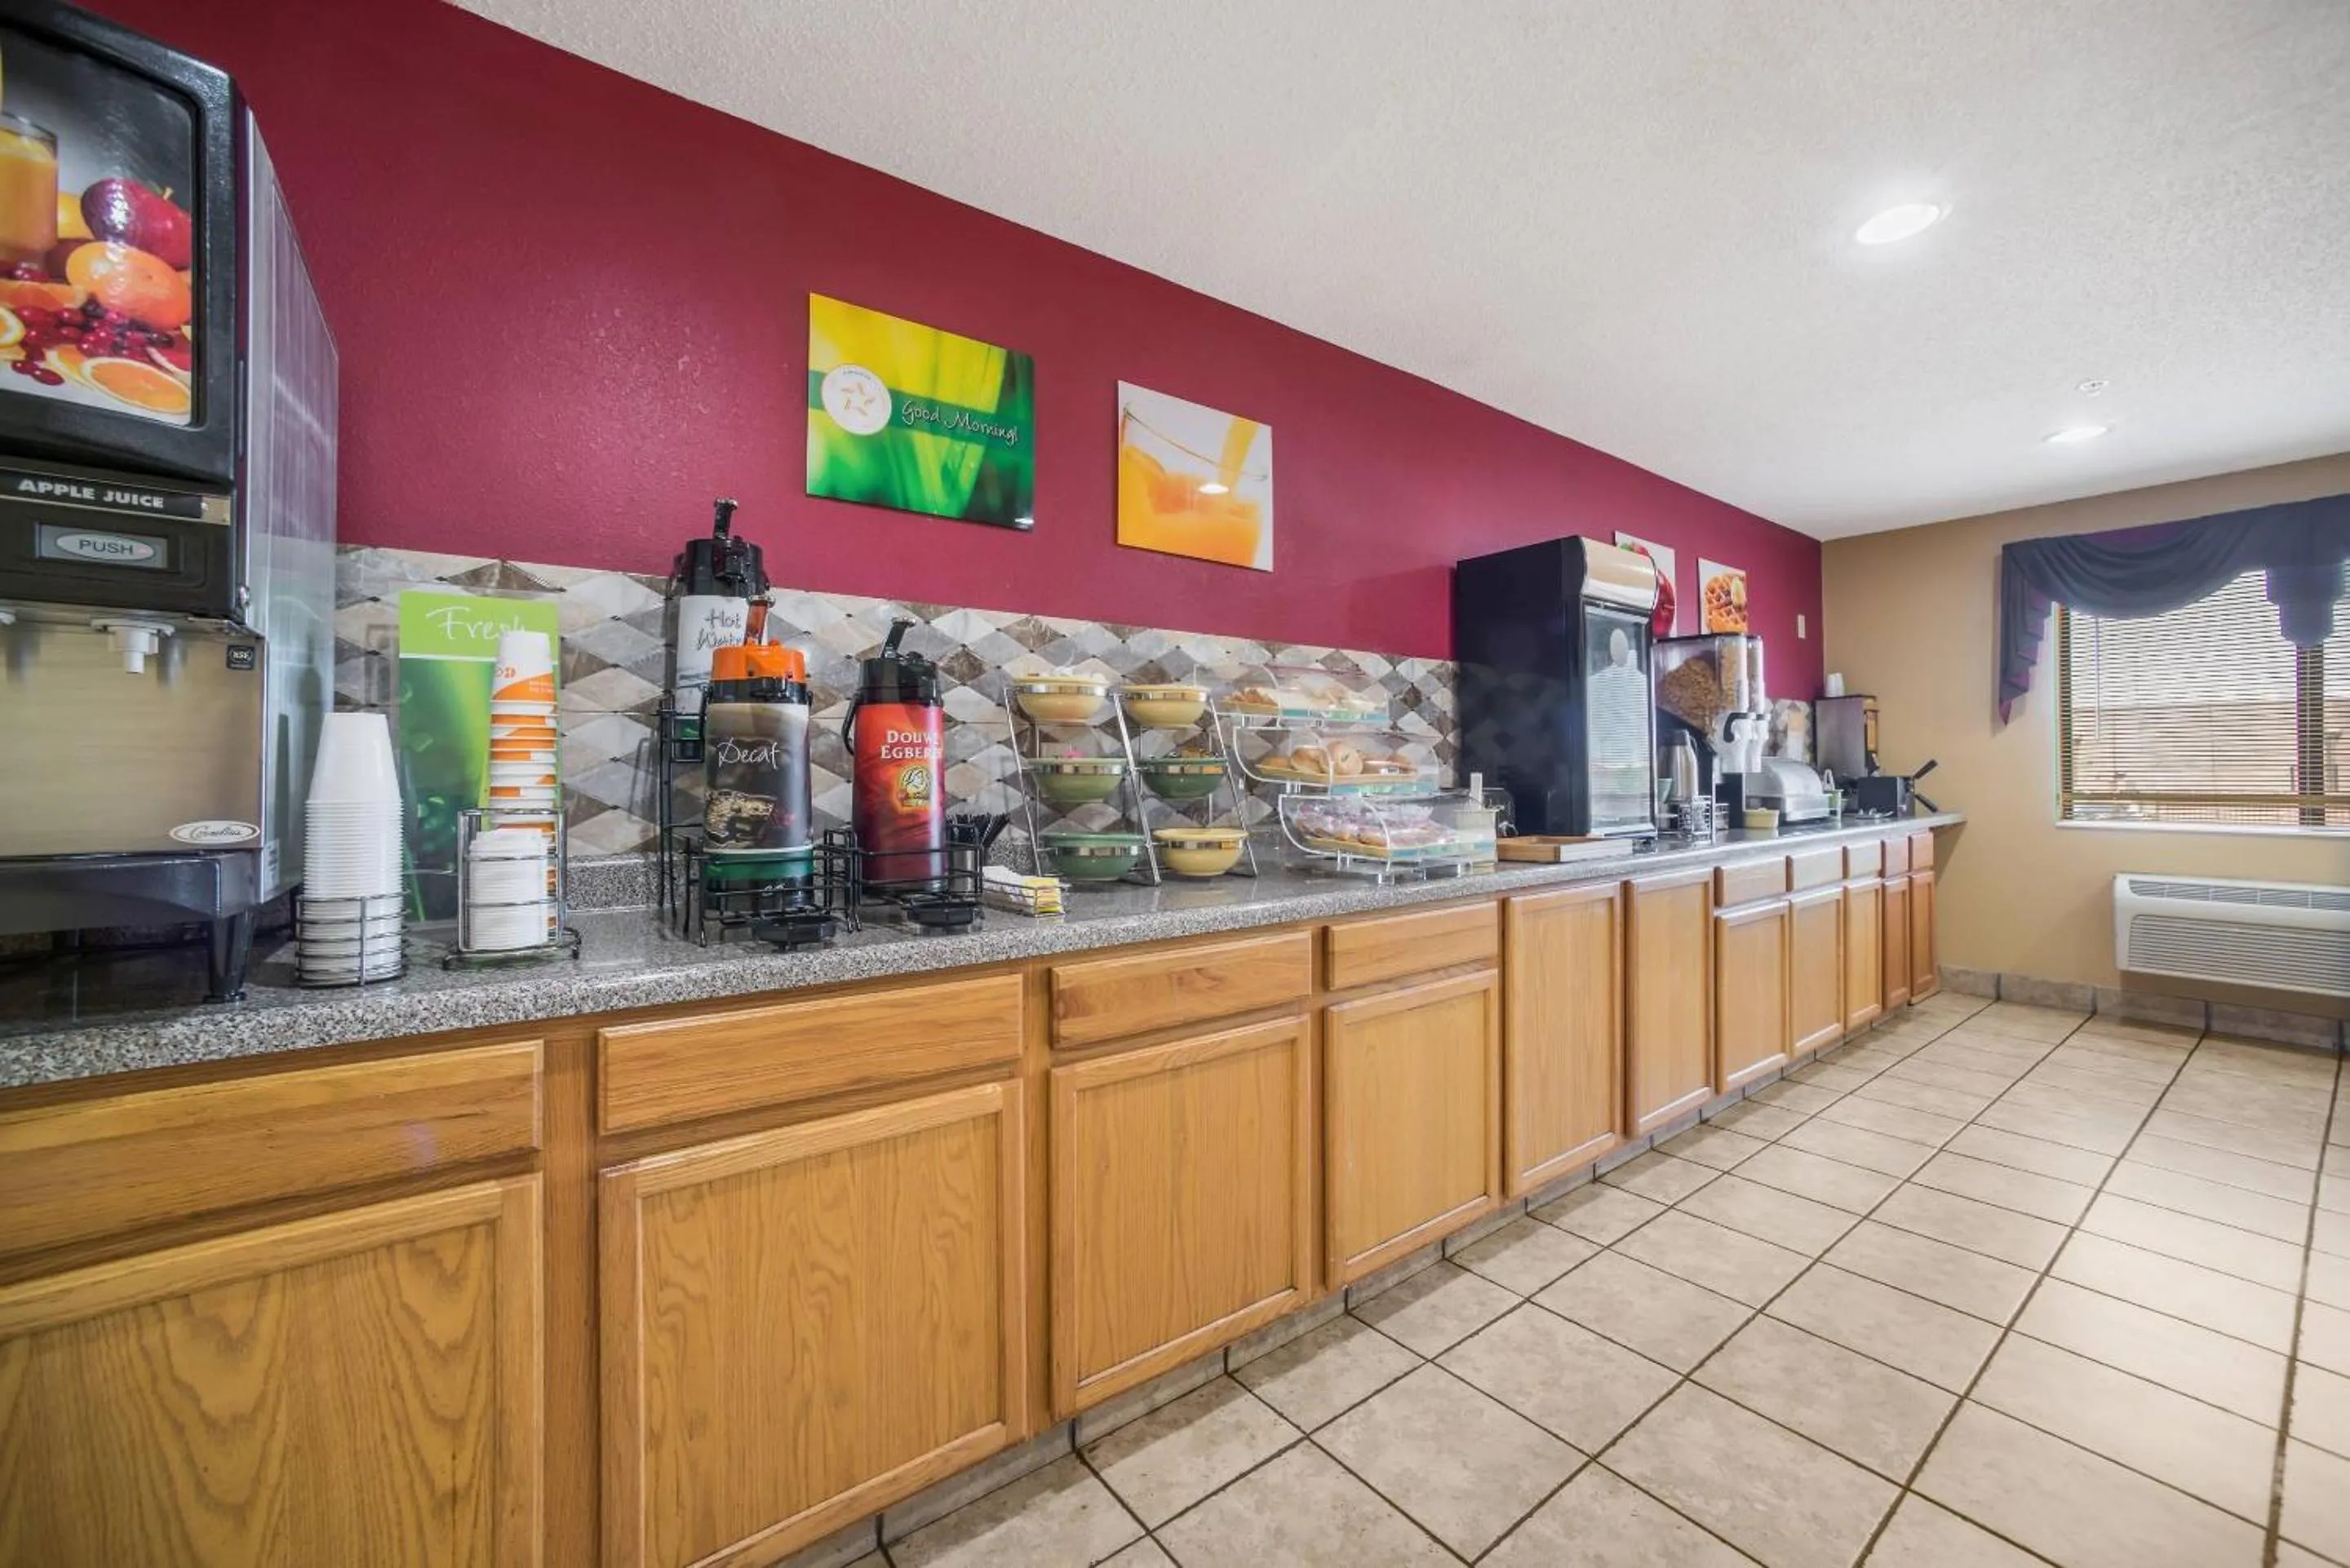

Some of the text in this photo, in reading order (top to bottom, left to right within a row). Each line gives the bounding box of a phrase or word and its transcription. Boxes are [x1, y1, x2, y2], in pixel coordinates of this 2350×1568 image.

[902, 401, 1018, 447] Good Morning!
[18, 478, 164, 508] APPLE JUICE
[79, 539, 134, 555] PUSH
[704, 608, 742, 629] Hot
[886, 729, 938, 745] DOUW
[716, 737, 781, 770] Decaf
[880, 744, 942, 760] EGBER
